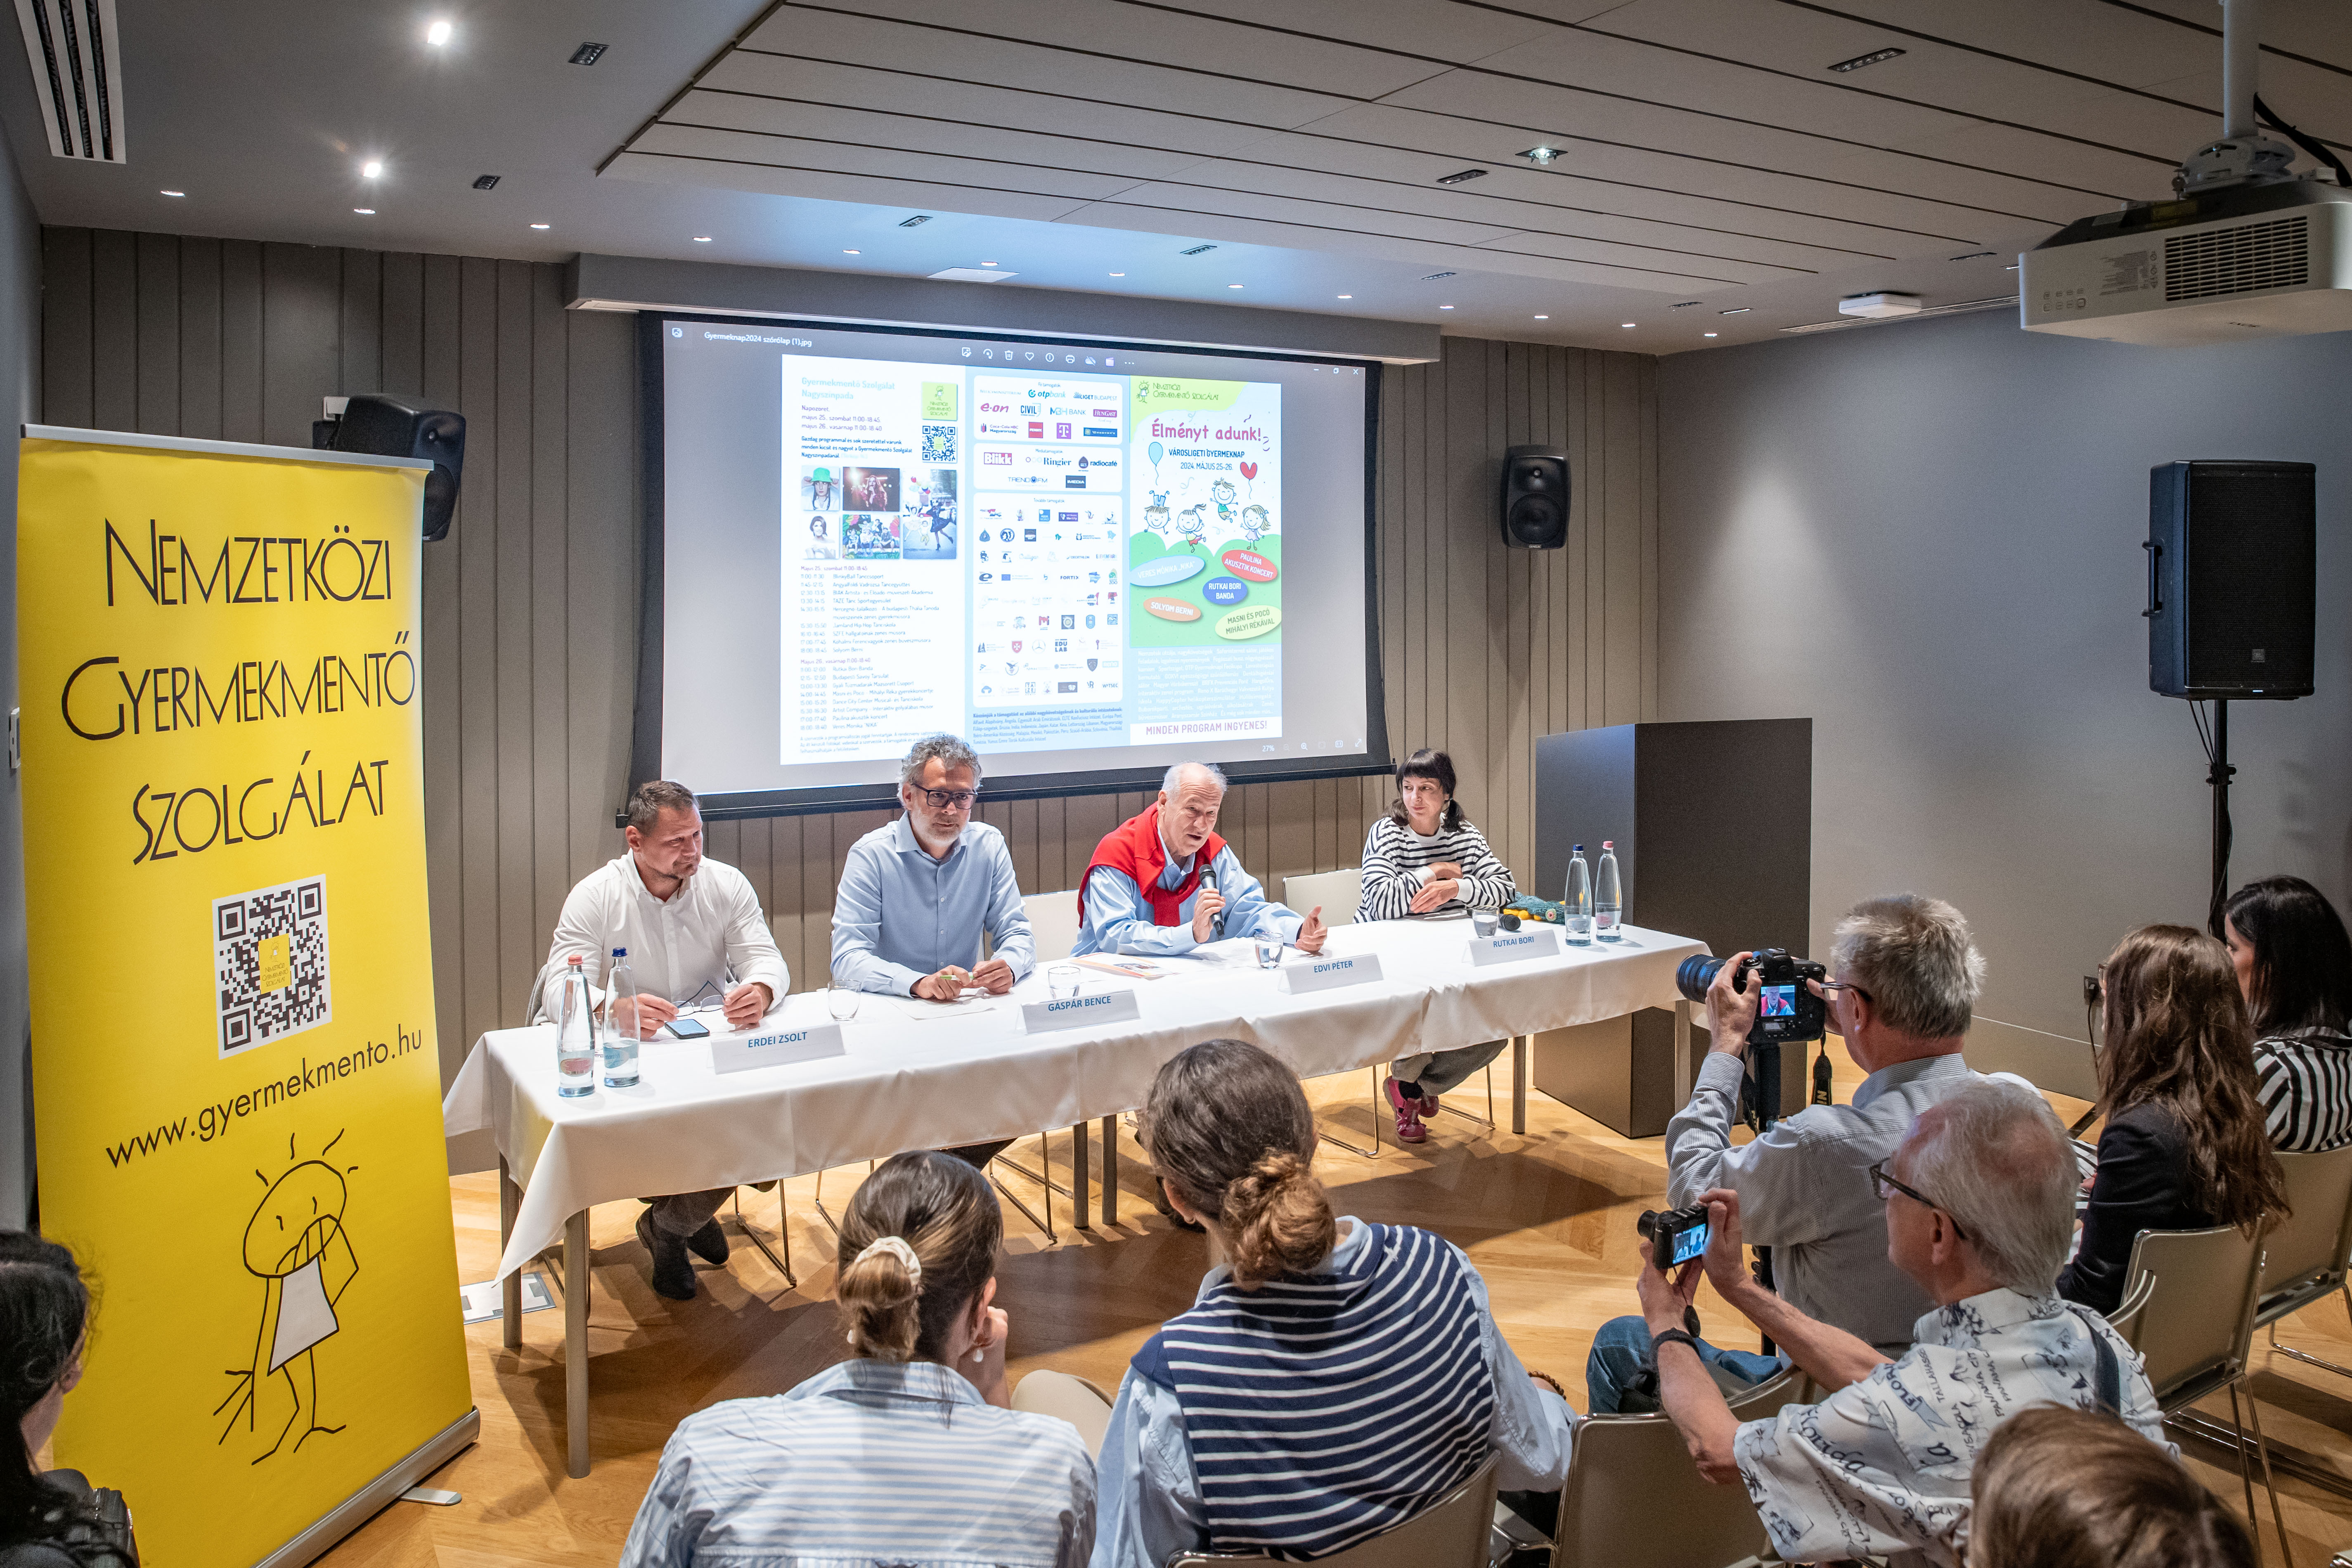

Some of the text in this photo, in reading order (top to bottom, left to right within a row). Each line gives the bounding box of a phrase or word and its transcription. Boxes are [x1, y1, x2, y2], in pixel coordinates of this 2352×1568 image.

[704, 331, 762, 342] Gyermeknap2024
[792, 337, 812, 348] (1).jpg
[1037, 390, 1066, 399] otpbank
[1020, 405, 1037, 414] CIVIL
[1152, 418, 1261, 442] Élményt adunk!
[984, 453, 1011, 465] Blikk
[1169, 447, 1245, 458] VÁROSLIGETI GYERMEKNAP
[1043, 457, 1072, 467] Ringier
[1196, 461, 1215, 470] MÁJUS
[105, 517, 392, 607] NEMZETKÖZI
[1240, 553, 1262, 565] PAULINA
[1138, 569, 1156, 579] VERES
[1156, 564, 1178, 576] MÓNIKA
[1224, 558, 1274, 579] AKUSZTIK KONCERT
[1175, 606, 1194, 616] BERNI
[1227, 607, 1270, 624] MASNI ÉS POCÓ
[1226, 618, 1275, 634] MIHÁLYI RÉKÁVAL
[61, 630, 416, 741] GYERMEKMENTŐ
[1146, 720, 1267, 735] MINDEN PROGRAM INGYENES!
[132, 750, 389, 865] SZOLGÁLAT
[1493, 936, 1534, 948] RUTKAI BORI
[1314, 960, 1353, 973] EDVI PÉTER
[1048, 996, 1111, 1012] GÁSPÁR BENCE
[748, 1031, 807, 1048] ERDEI ZSOLT
[105, 1024, 422, 1169] www.gyermekmento.hu
